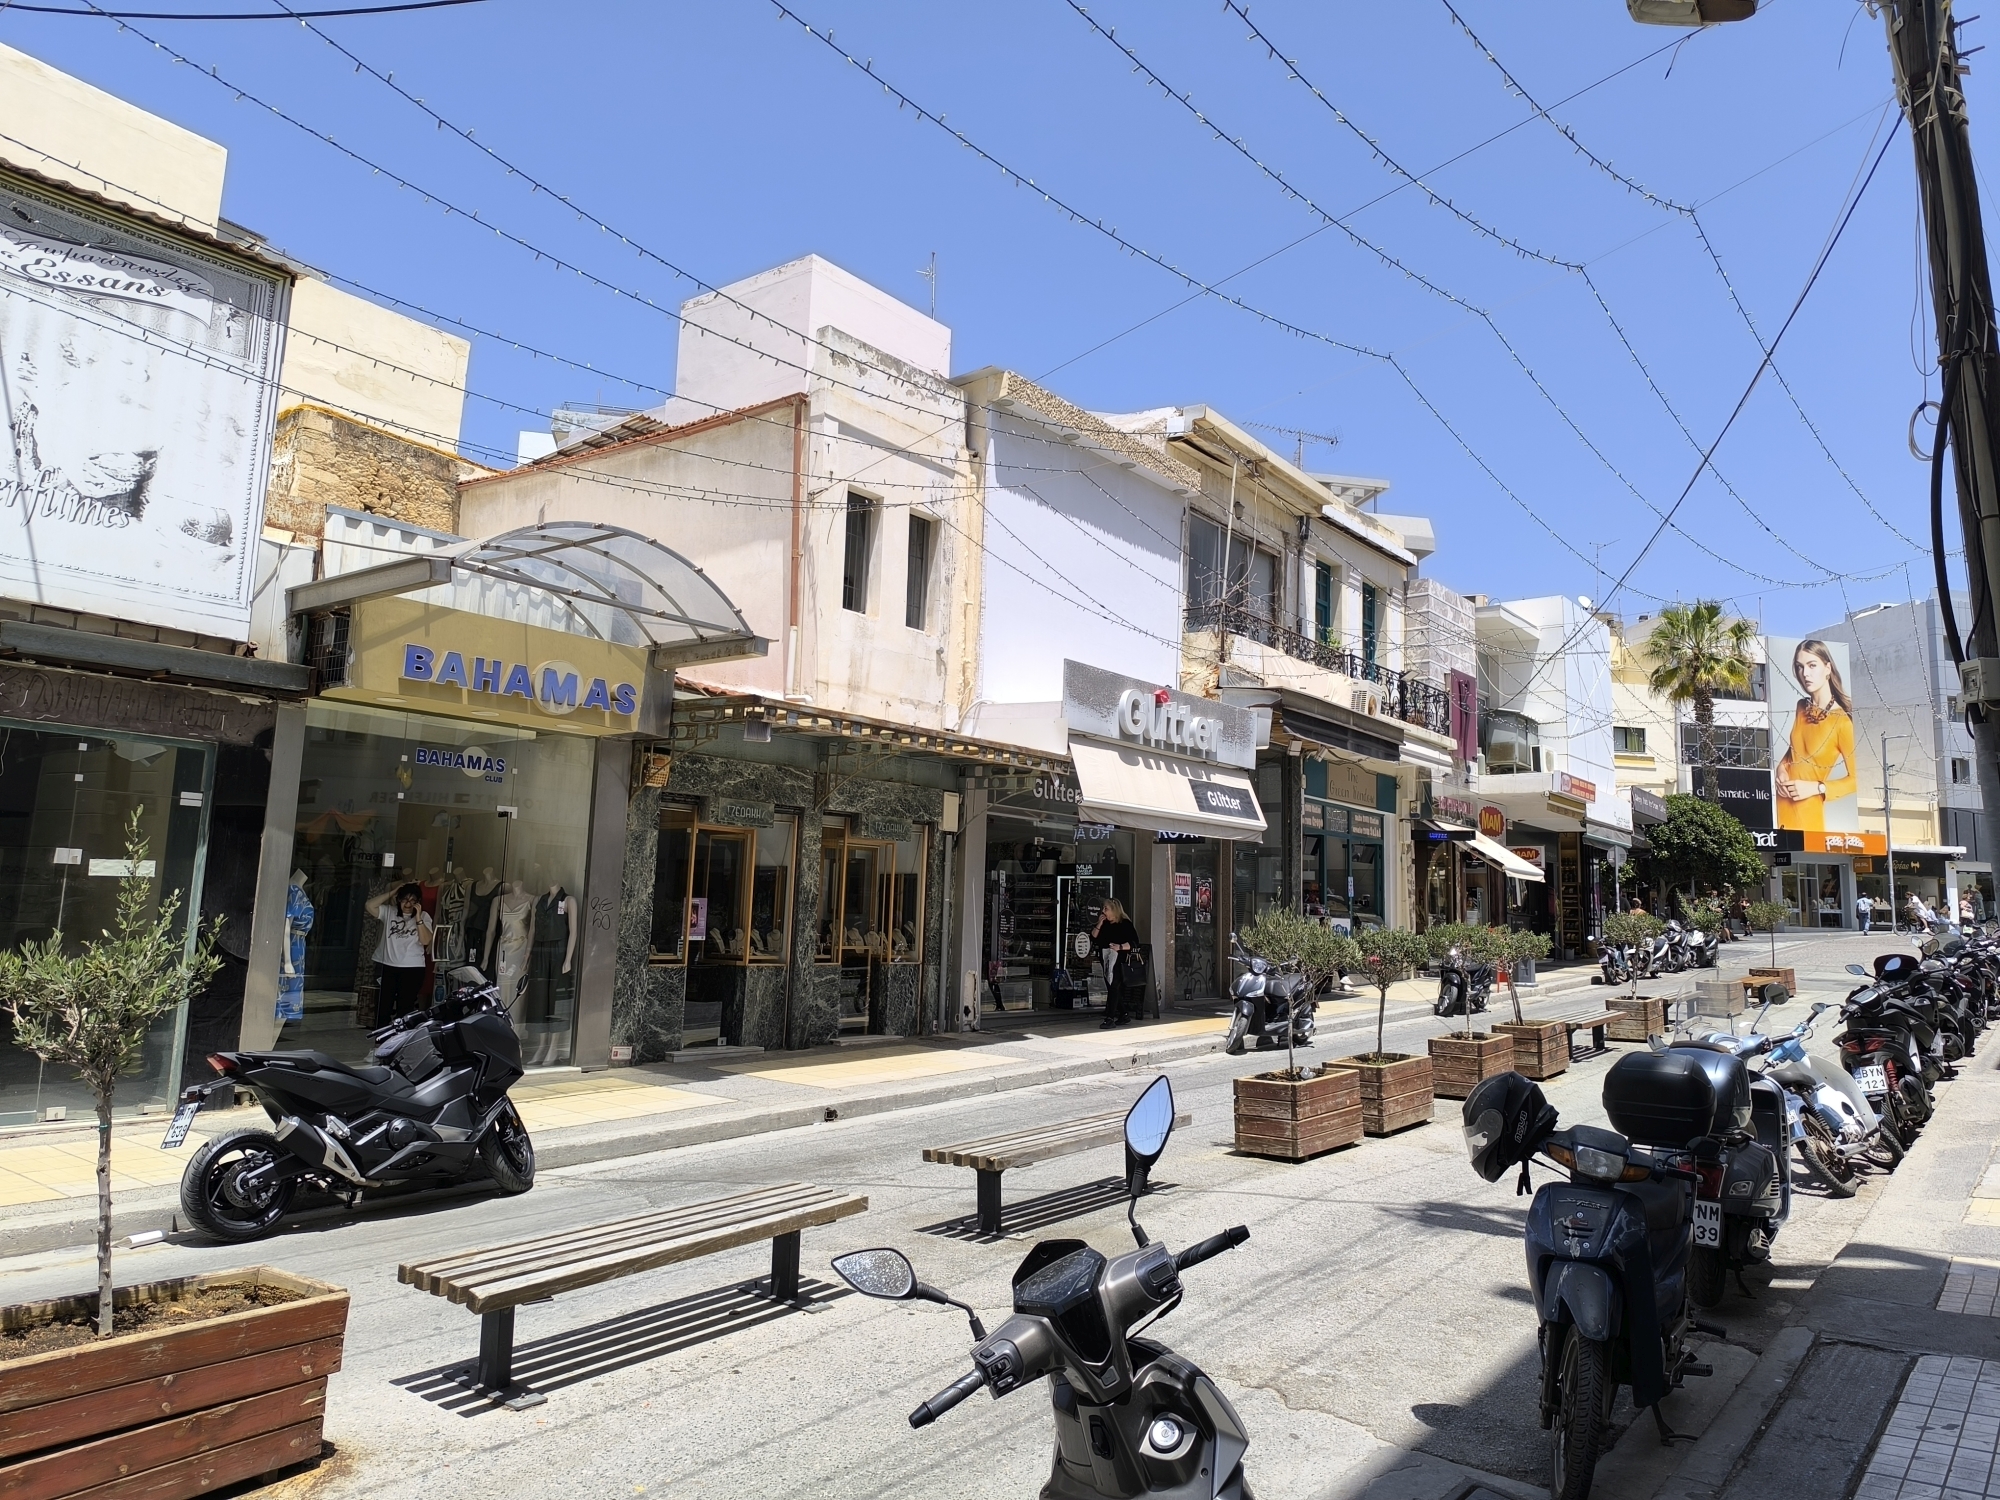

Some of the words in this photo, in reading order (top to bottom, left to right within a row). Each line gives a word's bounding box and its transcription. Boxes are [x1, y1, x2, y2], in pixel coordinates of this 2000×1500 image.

[402, 642, 637, 716] BAHAMAS
[1118, 688, 1224, 753] Glitter
[415, 746, 506, 774] BAHAMAS
[484, 774, 503, 784] CLUB
[1033, 778, 1081, 804] Glitter
[1207, 790, 1241, 811] Glitter
[1756, 788, 1770, 801] life
[1482, 810, 1501, 832] MAM
[1862, 1067, 1884, 1078] BYN
[1864, 1079, 1885, 1089] 121
[1696, 1225, 1718, 1242] 39
